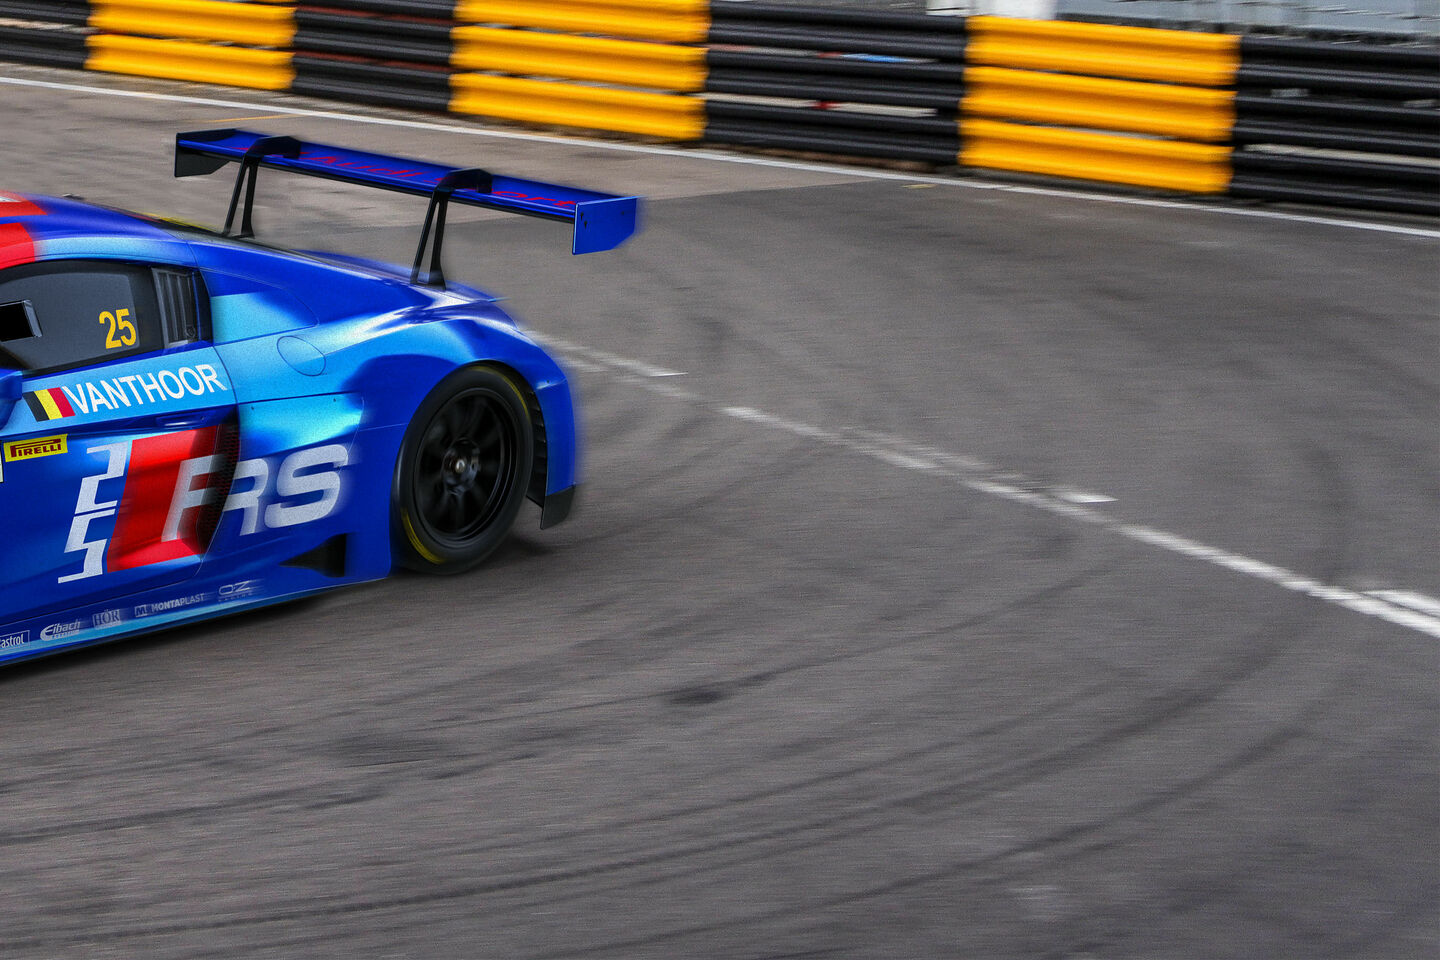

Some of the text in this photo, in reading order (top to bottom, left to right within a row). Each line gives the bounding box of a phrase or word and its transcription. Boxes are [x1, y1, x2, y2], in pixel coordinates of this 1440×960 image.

[99, 308, 137, 349] 25
[62, 364, 228, 414] VANTHOOR
[10, 437, 62, 458] PIRELLI
[151, 593, 205, 612] MONTAPLAST
[40, 619, 81, 641] Eibach
